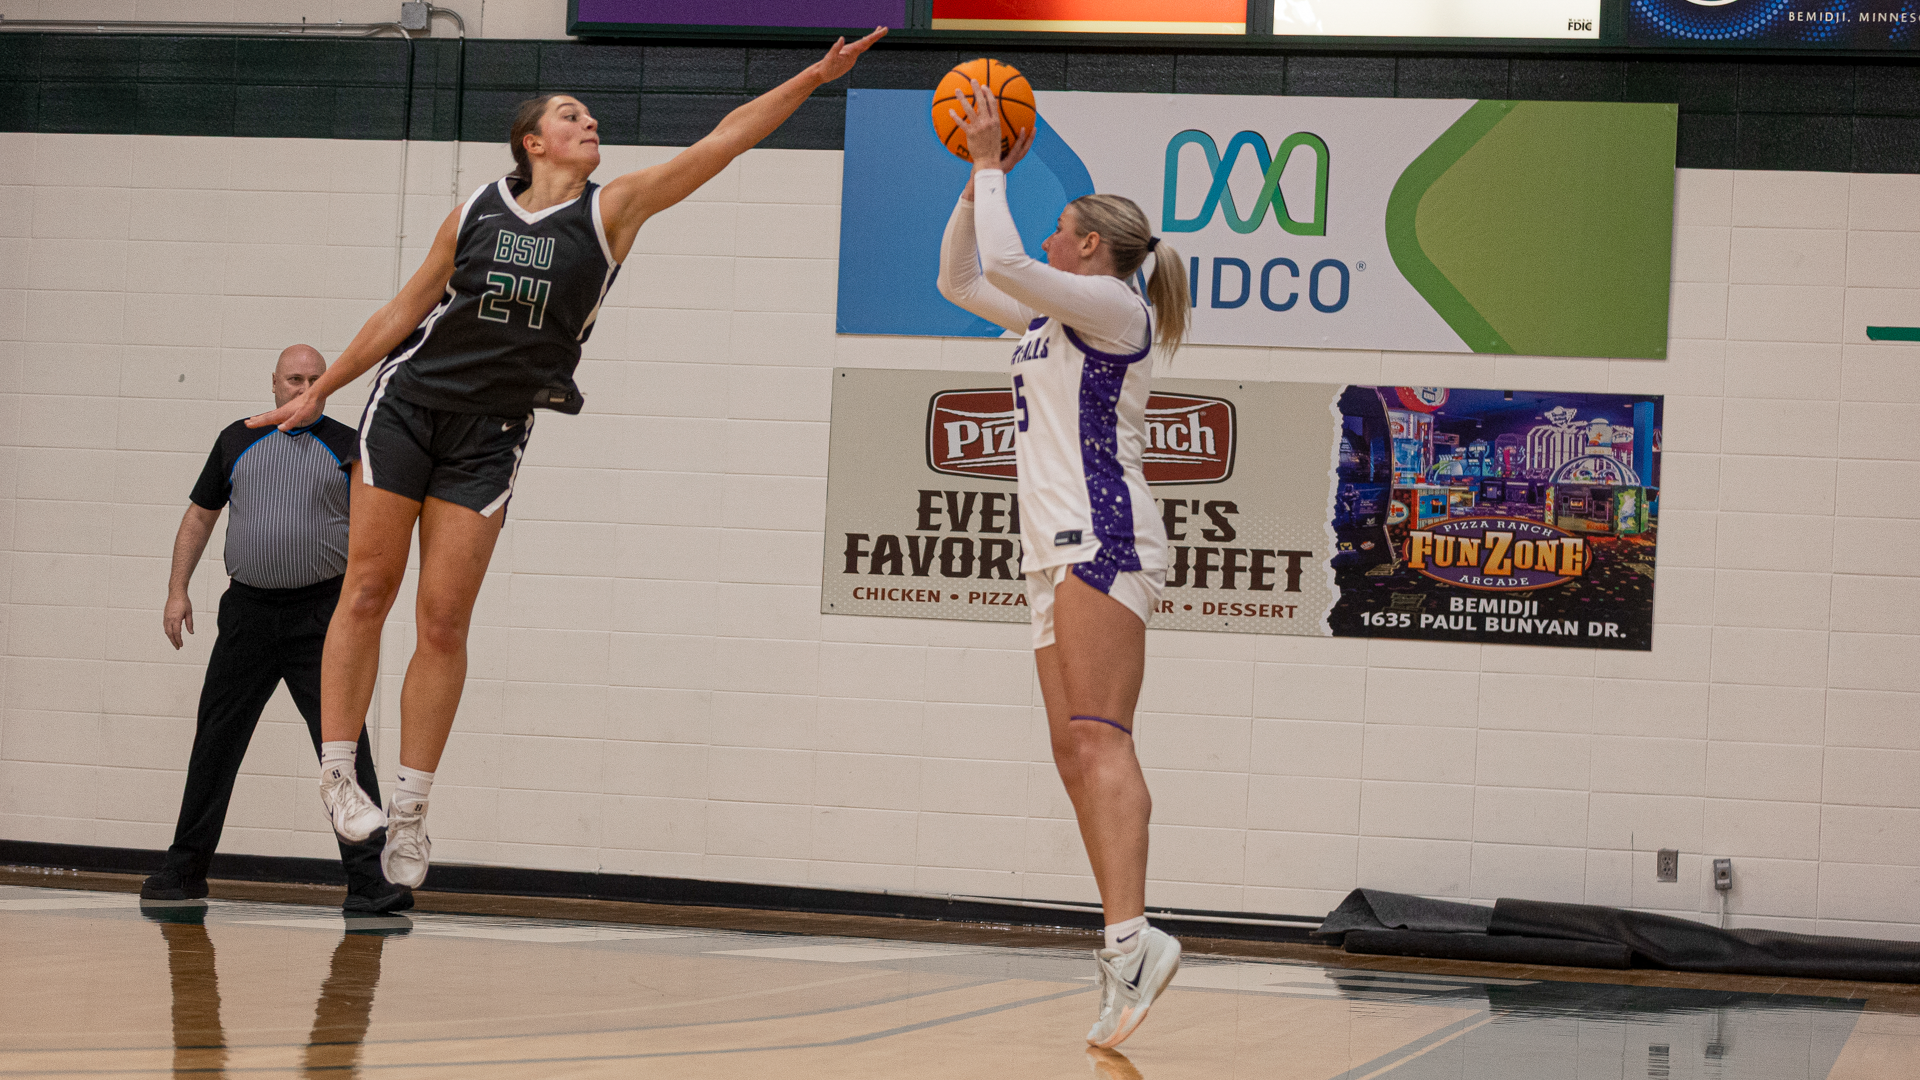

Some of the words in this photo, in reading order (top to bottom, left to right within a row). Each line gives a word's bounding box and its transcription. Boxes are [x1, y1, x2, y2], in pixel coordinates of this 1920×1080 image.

[1568, 22, 1592, 31] FDIC
[1859, 12, 1920, 23] MINNES
[493, 229, 555, 270] BSU
[477, 271, 552, 330] 24
[943, 420, 1016, 459] Piz
[1144, 411, 1217, 455] nch
[1443, 520, 1490, 533] PIZZA
[1496, 520, 1554, 537] RANCH
[843, 532, 1026, 580] FAVOR
[1165, 545, 1314, 593] UFFET
[1459, 574, 1530, 587] ARCADE
[852, 586, 941, 603] CHICKEN
[968, 591, 1028, 607] PIZZA
[1202, 601, 1298, 618] DESSERT
[1449, 597, 1539, 618] BEMIDJI
[1360, 611, 1412, 628] 1635
[1420, 613, 1478, 631] PAUL
[1484, 616, 1579, 636] BUNYAN
[1587, 621, 1627, 639] DR.
